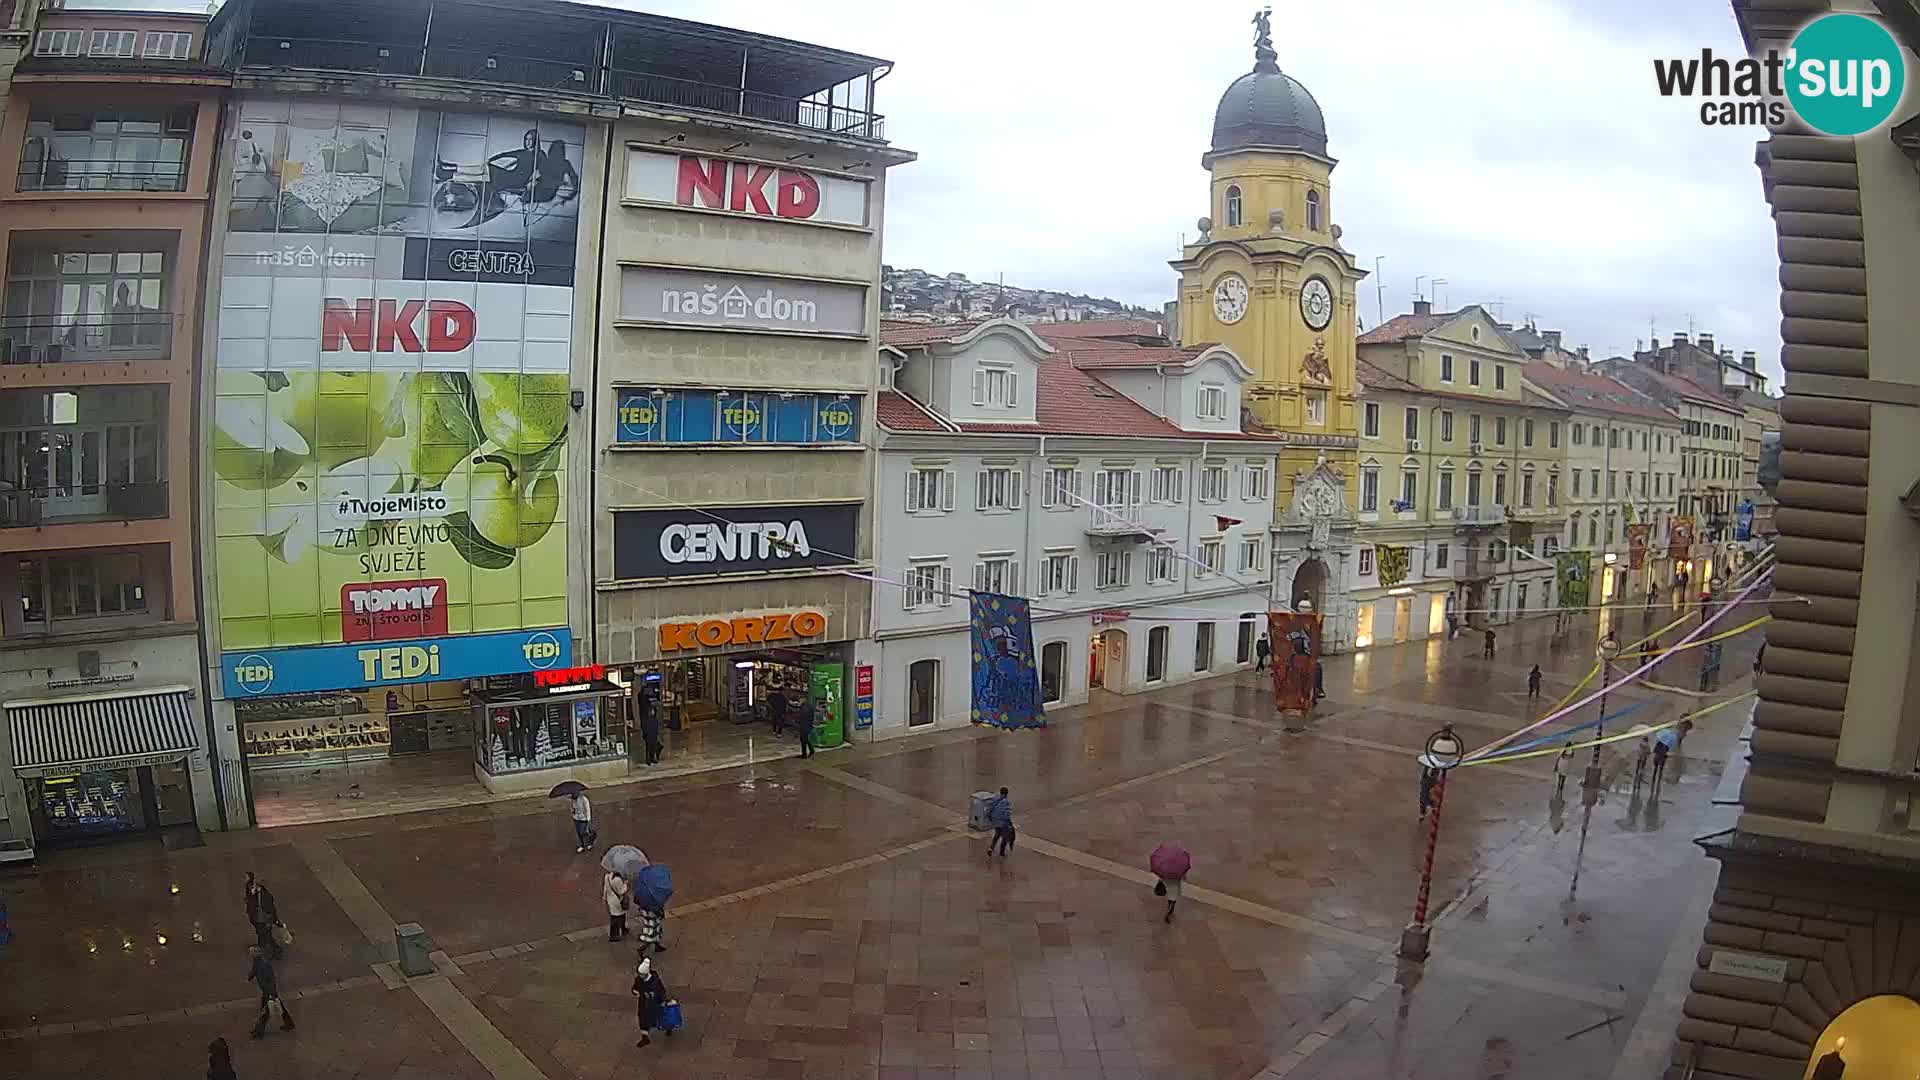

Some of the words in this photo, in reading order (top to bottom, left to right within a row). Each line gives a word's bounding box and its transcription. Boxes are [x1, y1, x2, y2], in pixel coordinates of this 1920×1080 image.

[676, 156, 820, 219] NKD
[448, 249, 535, 275] CENTRA
[662, 283, 717, 316] naš
[754, 289, 817, 323] dom
[322, 297, 477, 353] NKD
[620, 407, 658, 424] TEDi
[723, 408, 760, 425] TEDi
[820, 410, 853, 425] TEDi
[338, 497, 446, 516] #TvojeMisto
[334, 528, 358, 548] ZA
[367, 523, 451, 547] DNEVNO
[659, 519, 810, 565] CENTRA
[359, 546, 427, 574] SVJEŽE
[349, 586, 440, 614] TOMMY
[659, 611, 825, 651] KORZO
[358, 644, 440, 681] TEDi
[522, 642, 560, 660] TEDi
[234, 663, 273, 683] TEDi
